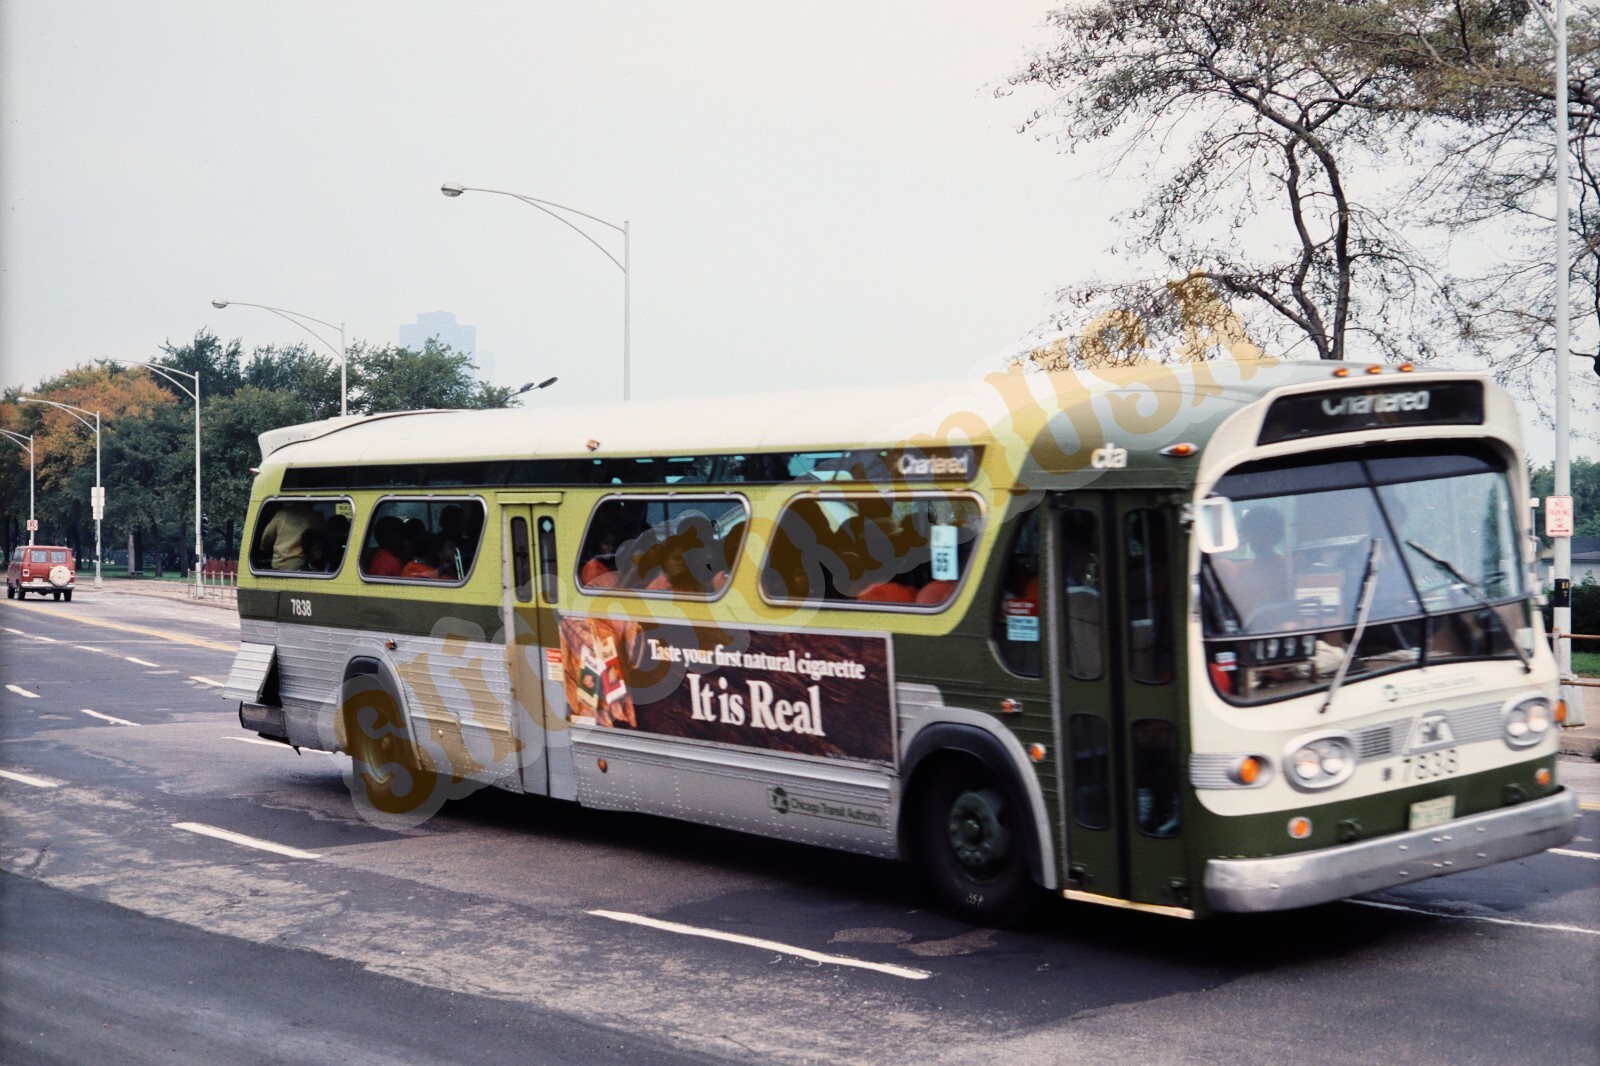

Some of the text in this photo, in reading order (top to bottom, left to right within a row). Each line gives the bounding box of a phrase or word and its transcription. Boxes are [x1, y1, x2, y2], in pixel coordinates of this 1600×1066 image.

[1090, 442, 1127, 469] cta
[290, 598, 312, 617] 7838
[647, 638, 867, 681] Taste your first natural cigarette
[686, 672, 827, 737] It is Real
